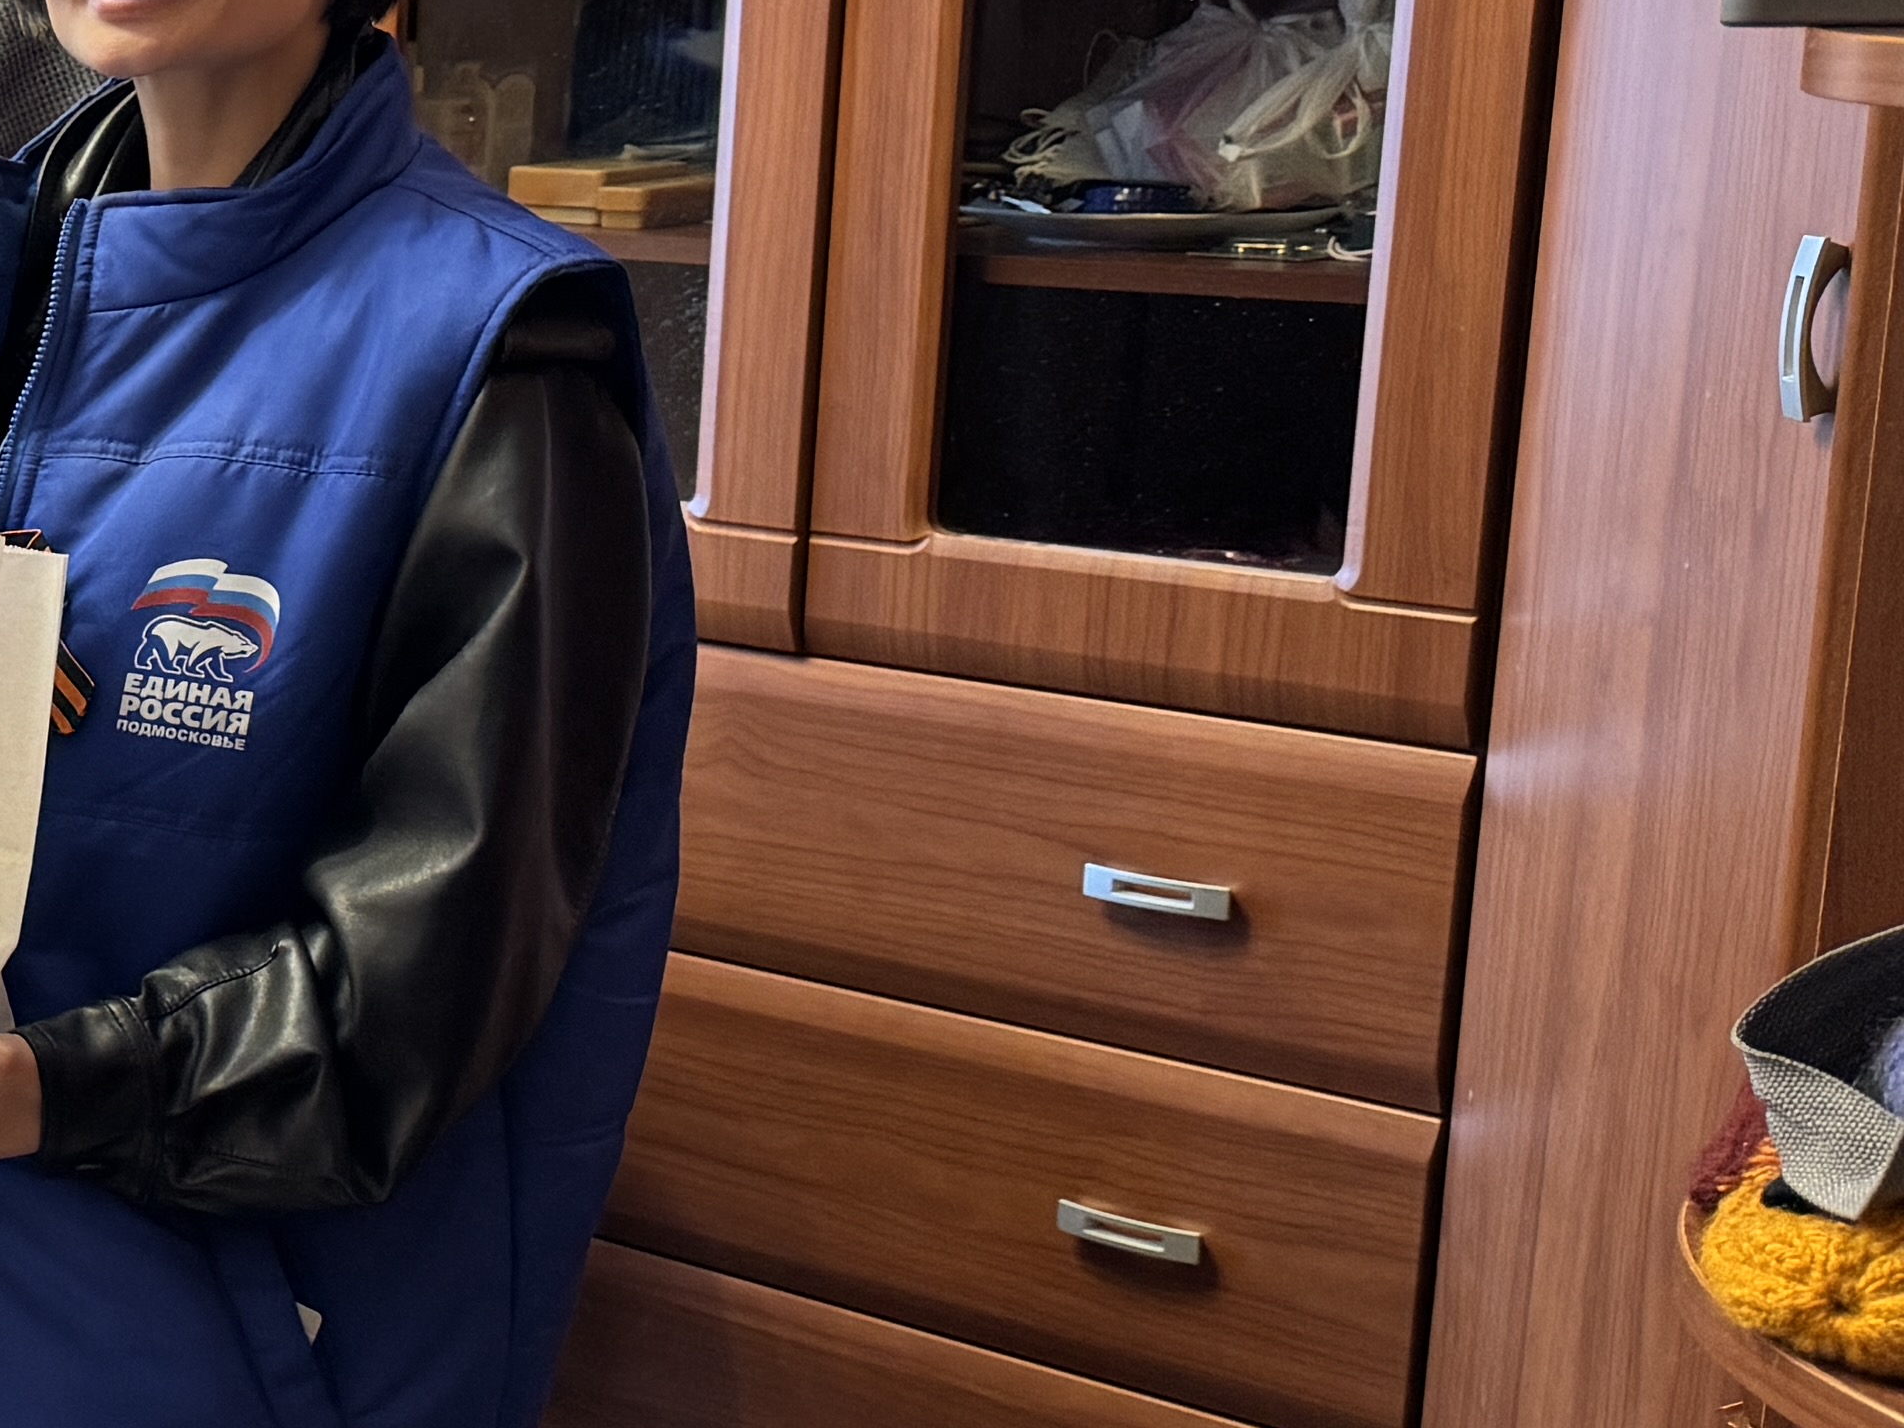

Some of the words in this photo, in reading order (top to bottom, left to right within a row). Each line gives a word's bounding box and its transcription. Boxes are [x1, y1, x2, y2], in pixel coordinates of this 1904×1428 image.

[123, 672, 254, 712] ЕДИНАЯ
[116, 718, 246, 751] ПОДМОСКОВЬЕ
[119, 695, 250, 736] РОССИЯ
